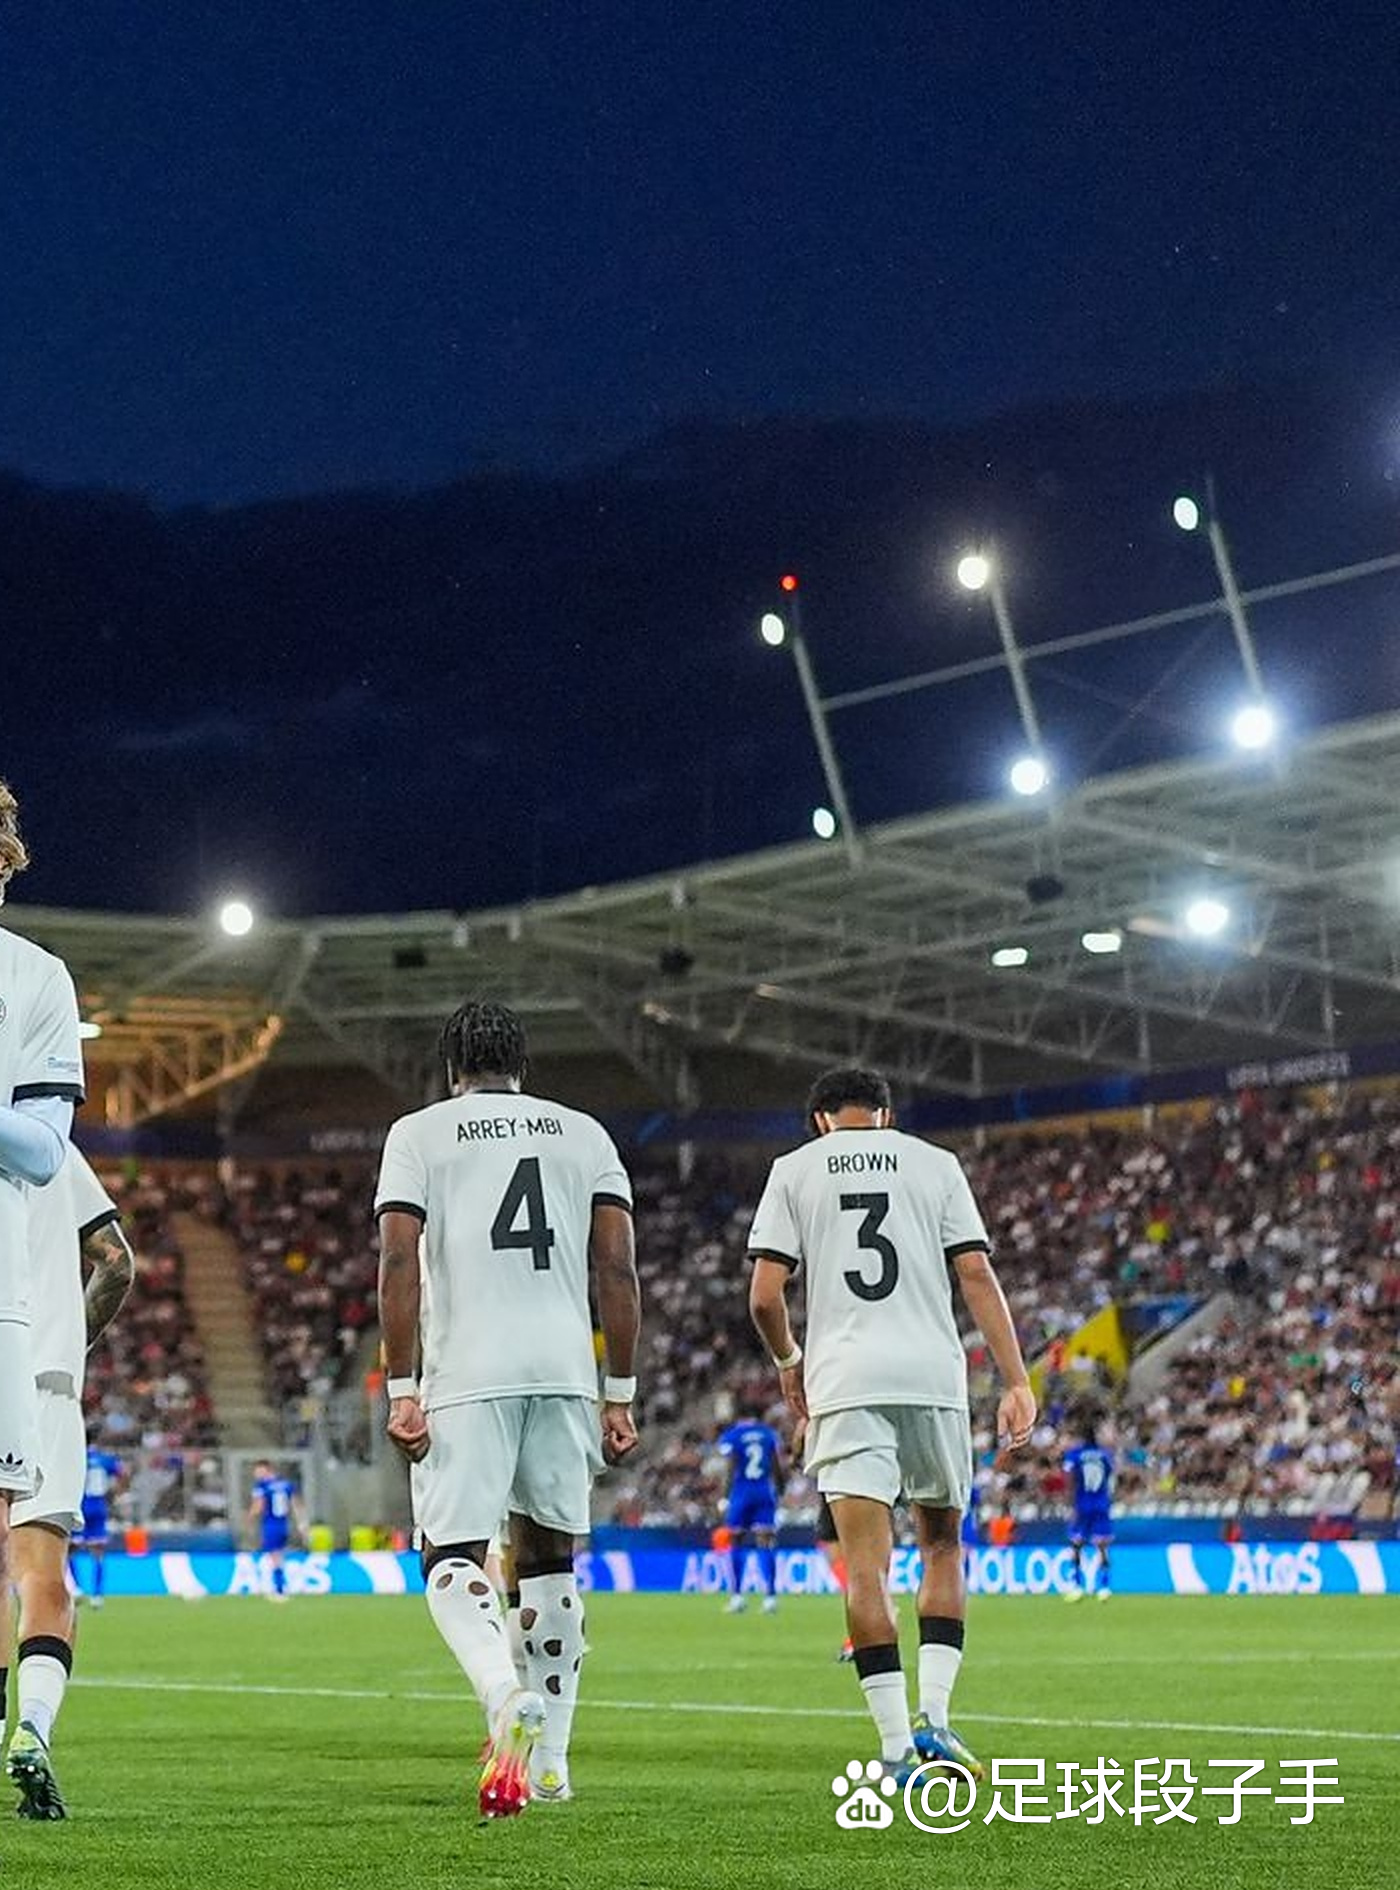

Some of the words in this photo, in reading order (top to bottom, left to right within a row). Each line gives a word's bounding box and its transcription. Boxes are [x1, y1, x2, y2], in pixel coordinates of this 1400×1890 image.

[457, 1117, 563, 1142] ARREY-MBI
[827, 1153, 898, 1174] BROWN
[490, 1156, 554, 1270] 4
[839, 1192, 899, 1302] 3
[745, 1442, 764, 1480] 2
